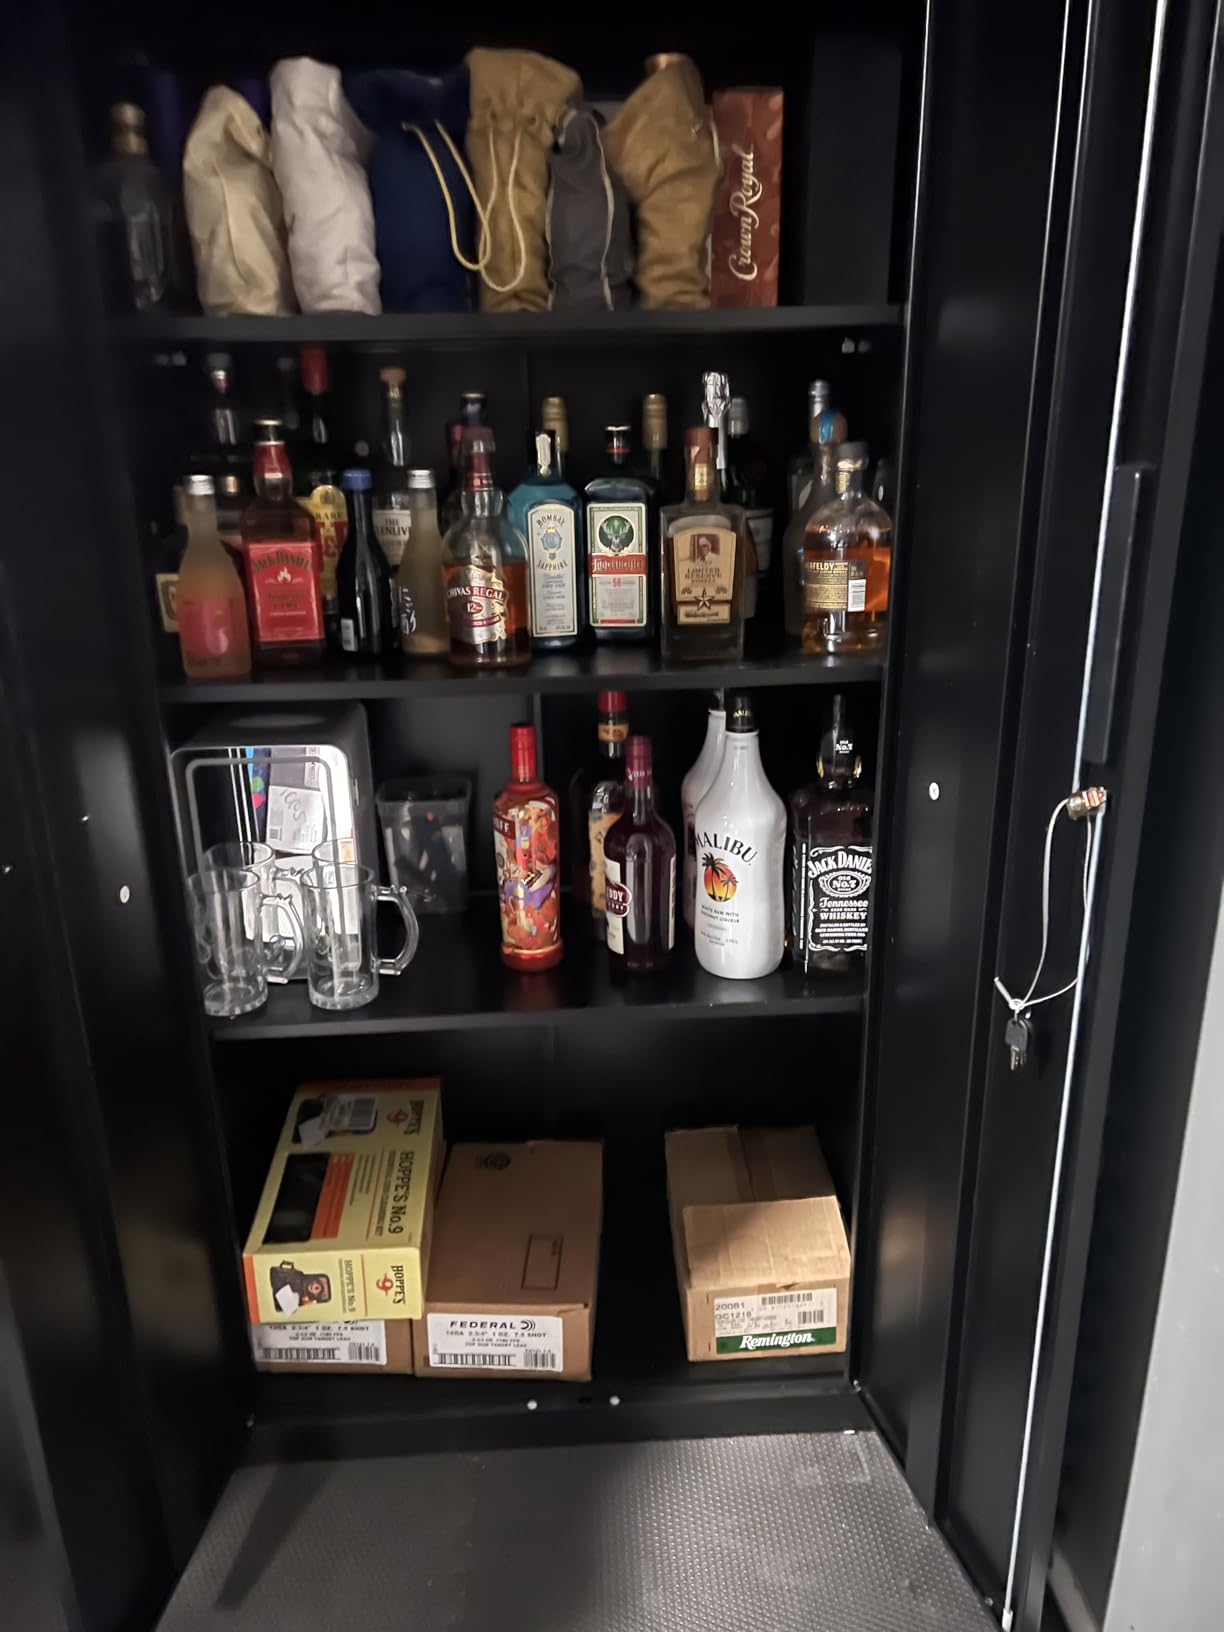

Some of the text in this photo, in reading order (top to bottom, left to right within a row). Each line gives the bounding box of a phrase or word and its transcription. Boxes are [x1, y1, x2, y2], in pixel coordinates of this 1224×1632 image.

[729, 144, 763, 281] Crown Royal
[536, 513, 565, 527] BOMBAY
[536, 560, 569, 571] SAPPHIRE
[473, 586, 504, 600] REGAL
[466, 602, 476, 613] 12
[807, 850, 873, 878] JACK DANIE
[832, 880, 857, 889] No.7
[819, 897, 868, 908] Tennessee
[820, 911, 868, 920] WHISKEY
[387, 1151, 415, 1235] HOPPE'S No.9
[376, 1277, 394, 1292] 9
[390, 1264, 407, 1305] HOPPE'S
[450, 1320, 517, 1330] FEDERAL
[739, 1332, 813, 1350] Remington
